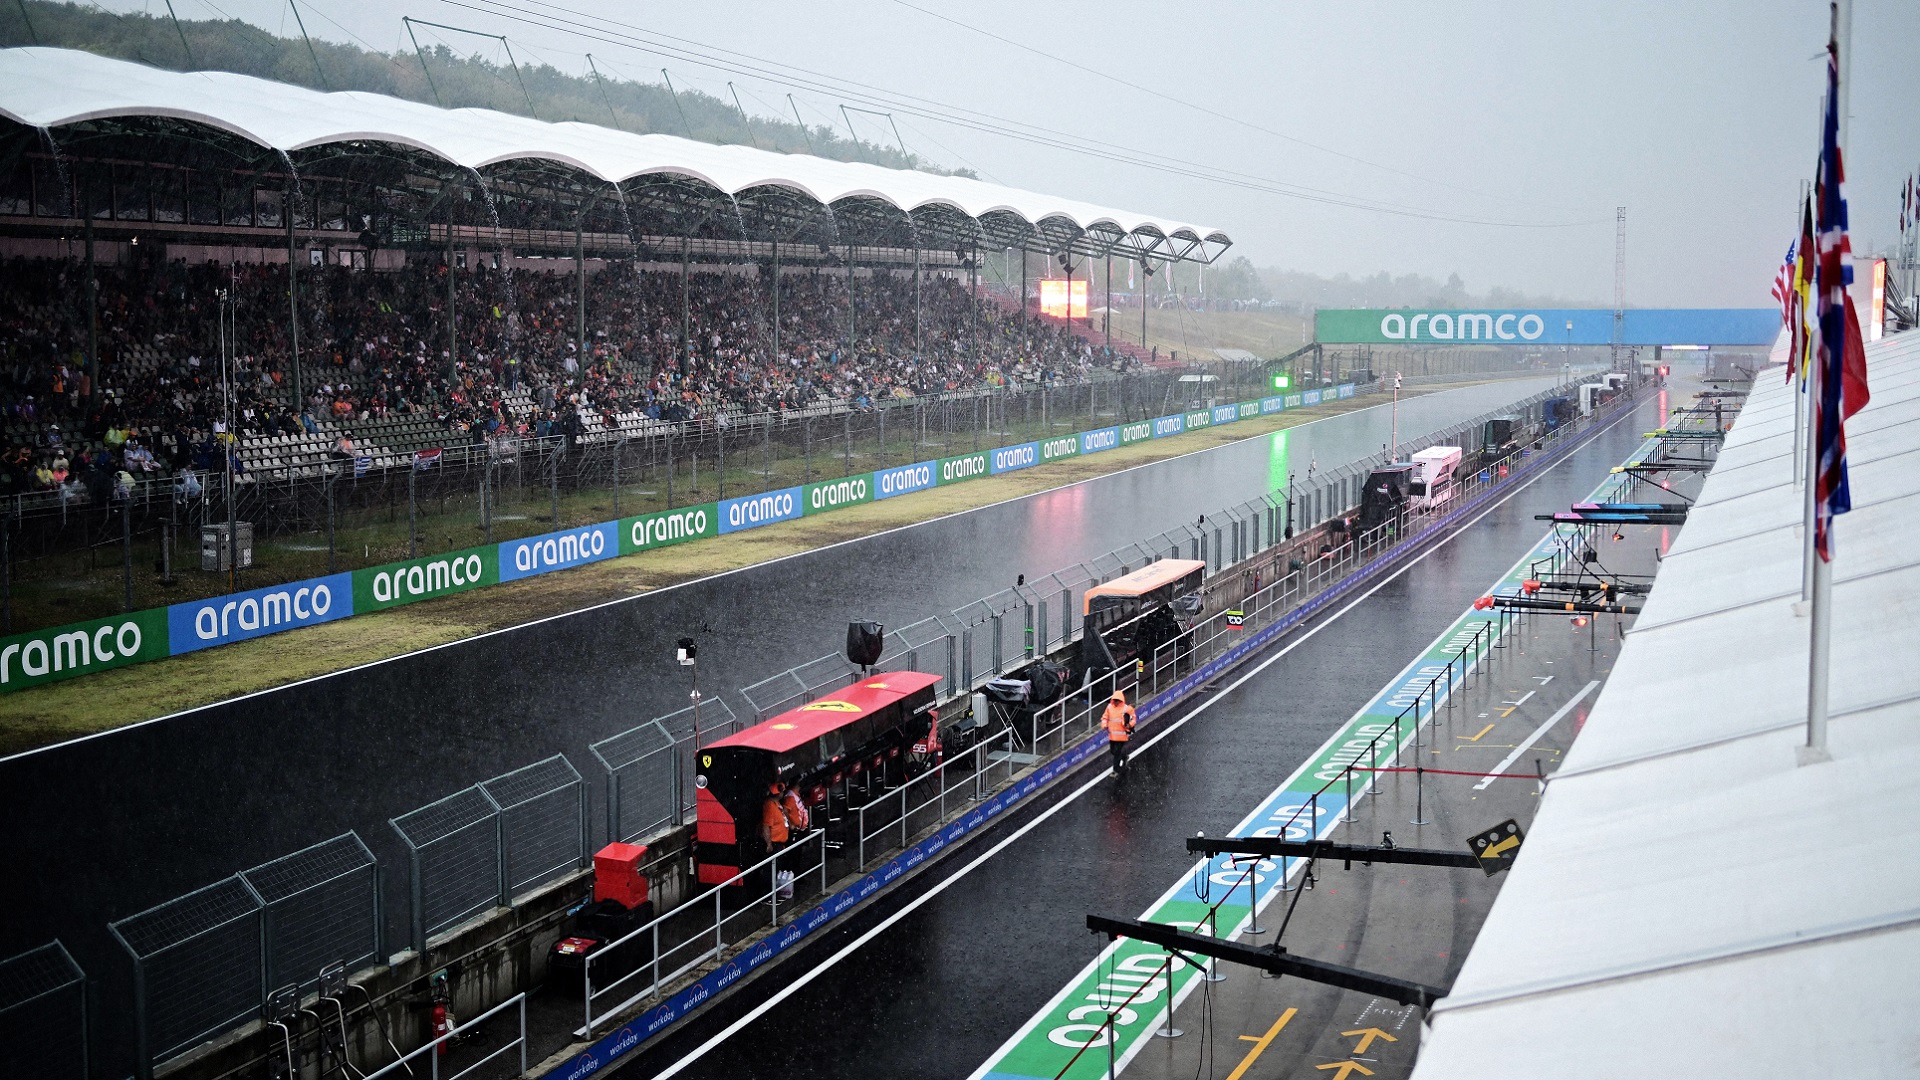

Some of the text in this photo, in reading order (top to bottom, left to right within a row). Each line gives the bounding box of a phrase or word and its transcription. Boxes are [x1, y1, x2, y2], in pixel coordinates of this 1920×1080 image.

[1381, 314, 1544, 340] aramco
[1215, 407, 1236, 422] aramco
[1240, 402, 1259, 416] aramco
[1263, 398, 1281, 412] aramco
[1157, 417, 1181, 434] aramco
[1187, 412, 1209, 427] aramco
[1086, 430, 1114, 450] aramco
[1123, 423, 1149, 441] aramco
[997, 447, 1034, 467] aramco
[1044, 438, 1077, 458] aramco
[943, 455, 985, 480] aramco
[882, 466, 930, 494] aramco
[812, 479, 866, 508] aramco
[730, 494, 793, 526] aramco
[632, 510, 706, 546] aramco
[516, 529, 604, 571] aramco
[373, 554, 482, 602] aramco
[196, 584, 331, 640] aramco
[0, 621, 141, 683] ramco
[913, 744, 927, 753] 55
[1314, 725, 1402, 780] aramco
[808, 911, 828, 928] workday
[780, 929, 800, 947] workday
[750, 948, 771, 966] workday
[717, 967, 741, 988] workday
[683, 988, 708, 1010] workday
[648, 1010, 674, 1032] workday
[610, 1032, 638, 1056] workday
